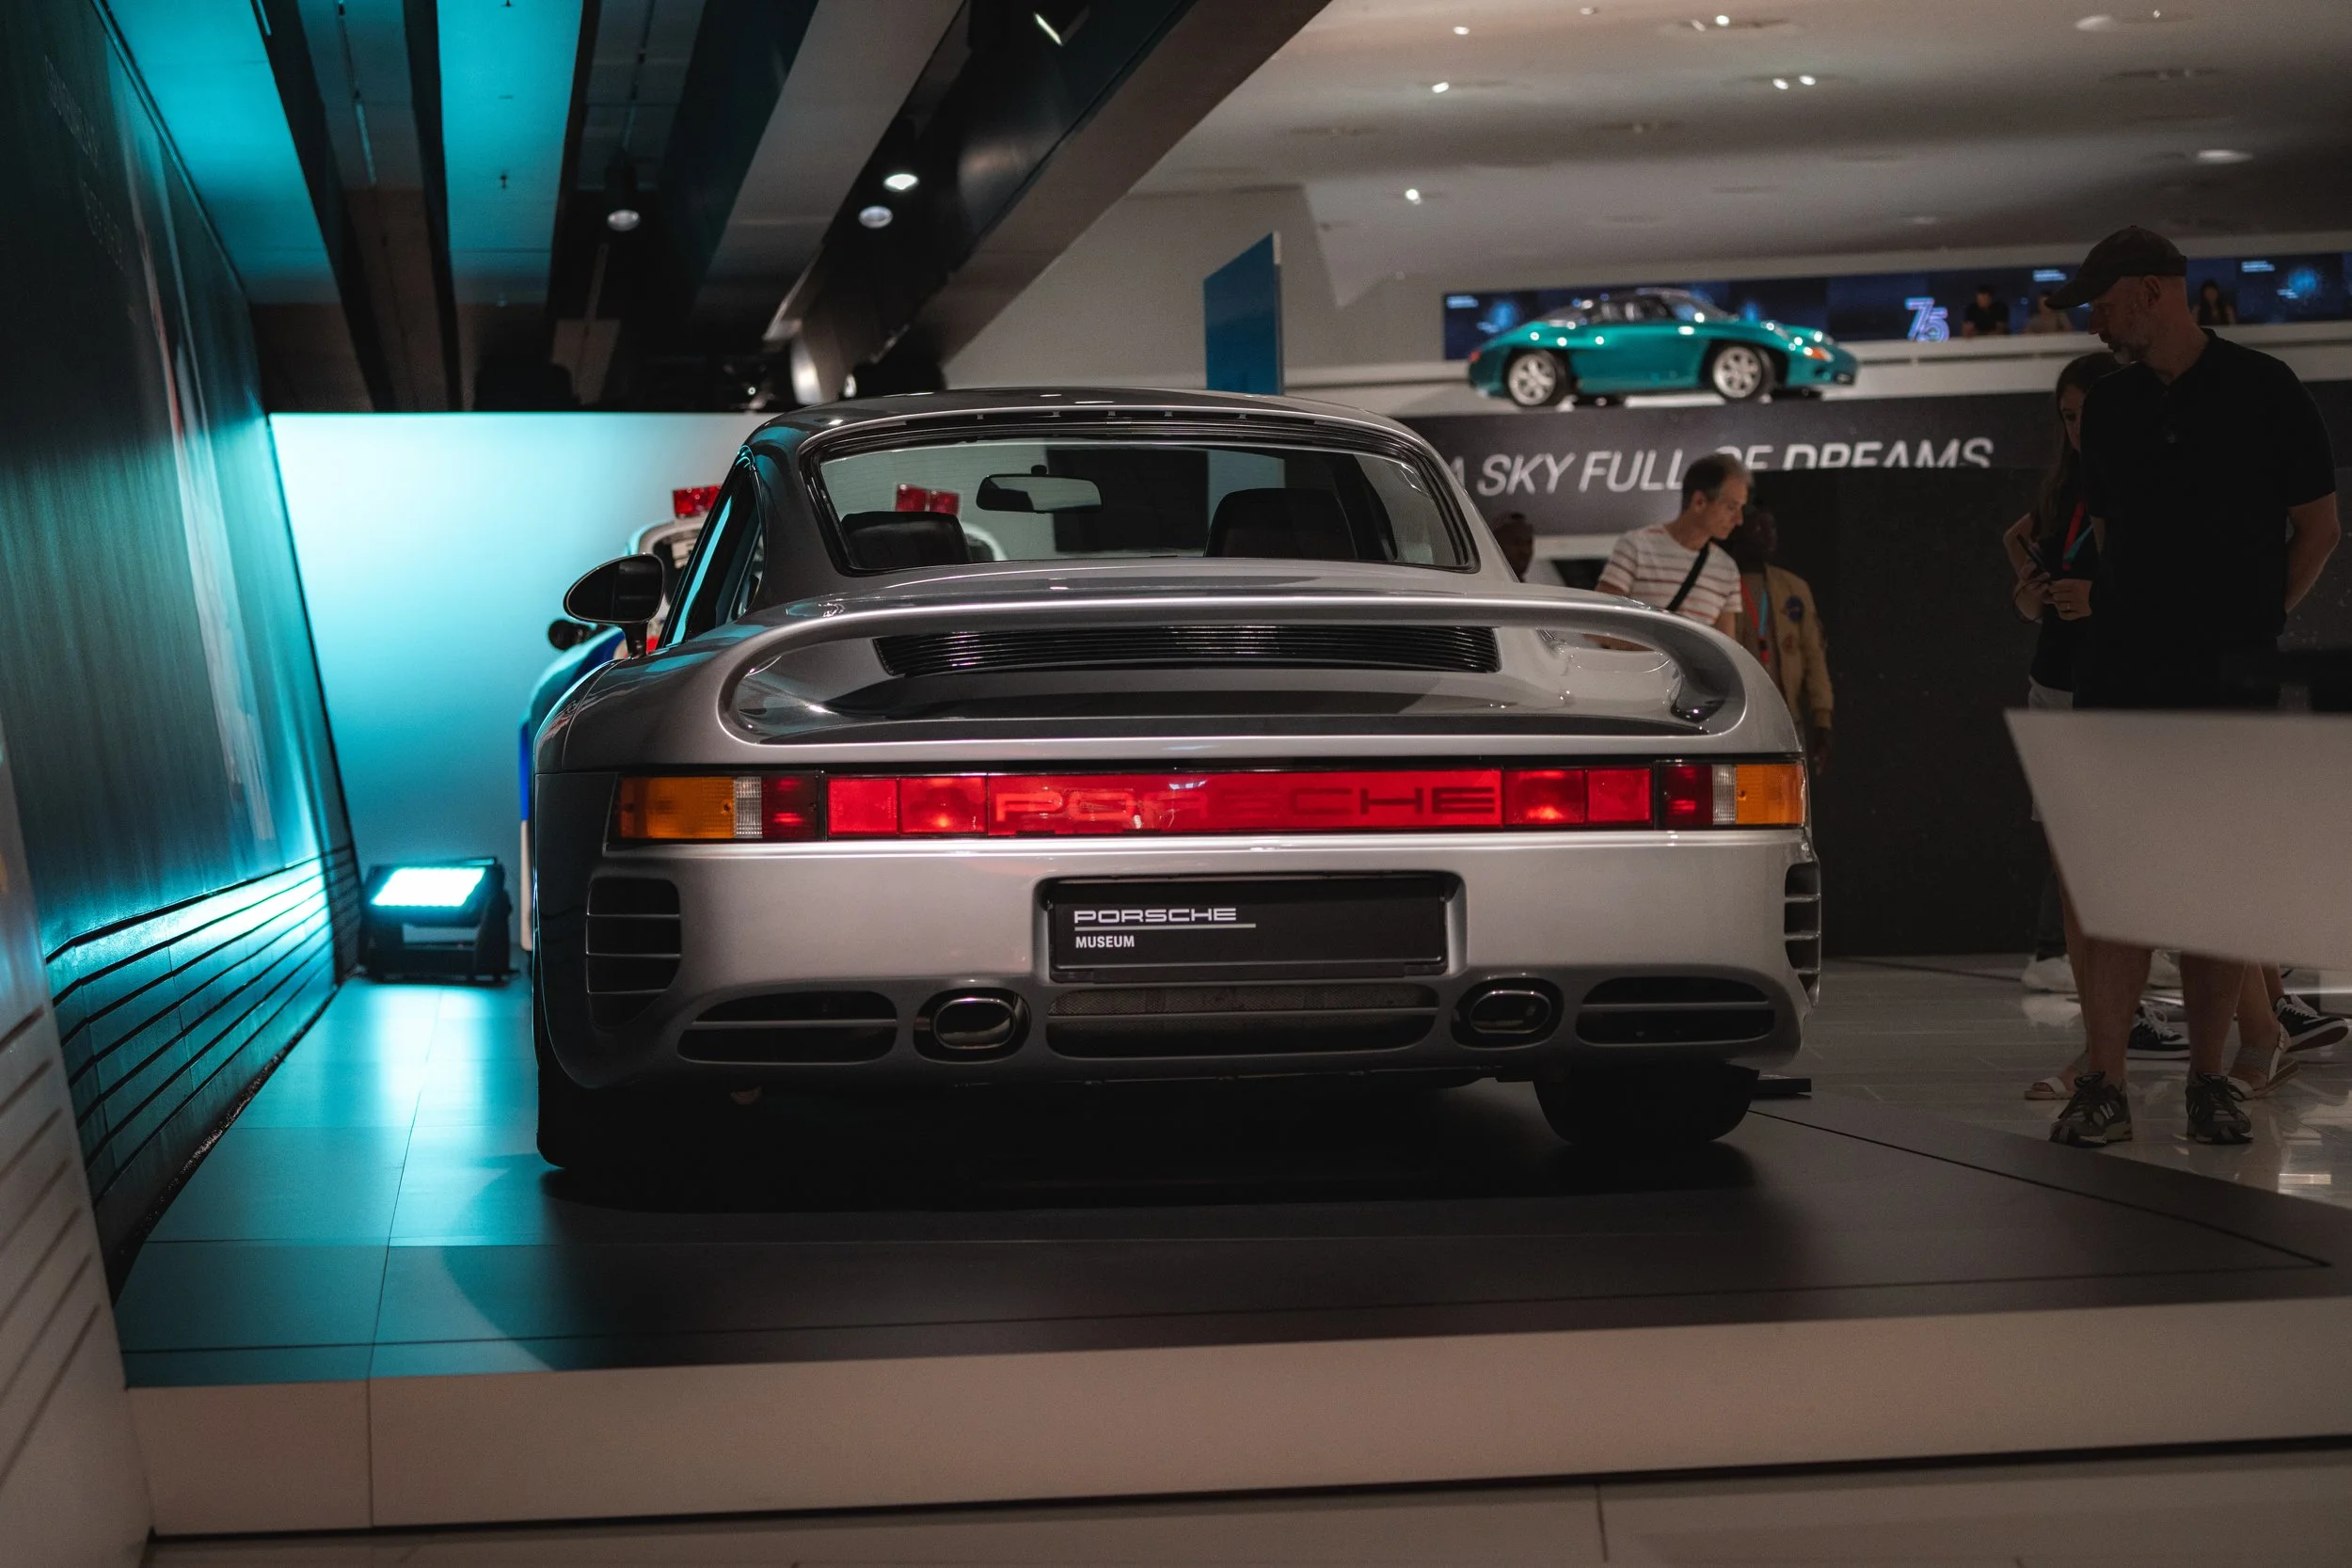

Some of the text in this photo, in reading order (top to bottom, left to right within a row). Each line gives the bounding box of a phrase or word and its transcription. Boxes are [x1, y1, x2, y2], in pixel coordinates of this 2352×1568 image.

[1904, 297, 1950, 342] 75
[1476, 451, 1577, 496] SKY
[1578, 448, 1683, 493] FULL
[995, 786, 1495, 823] PORSCHE
[1073, 908, 1237, 925] PORSCHE
[1075, 935, 1136, 950] MUSEUM
